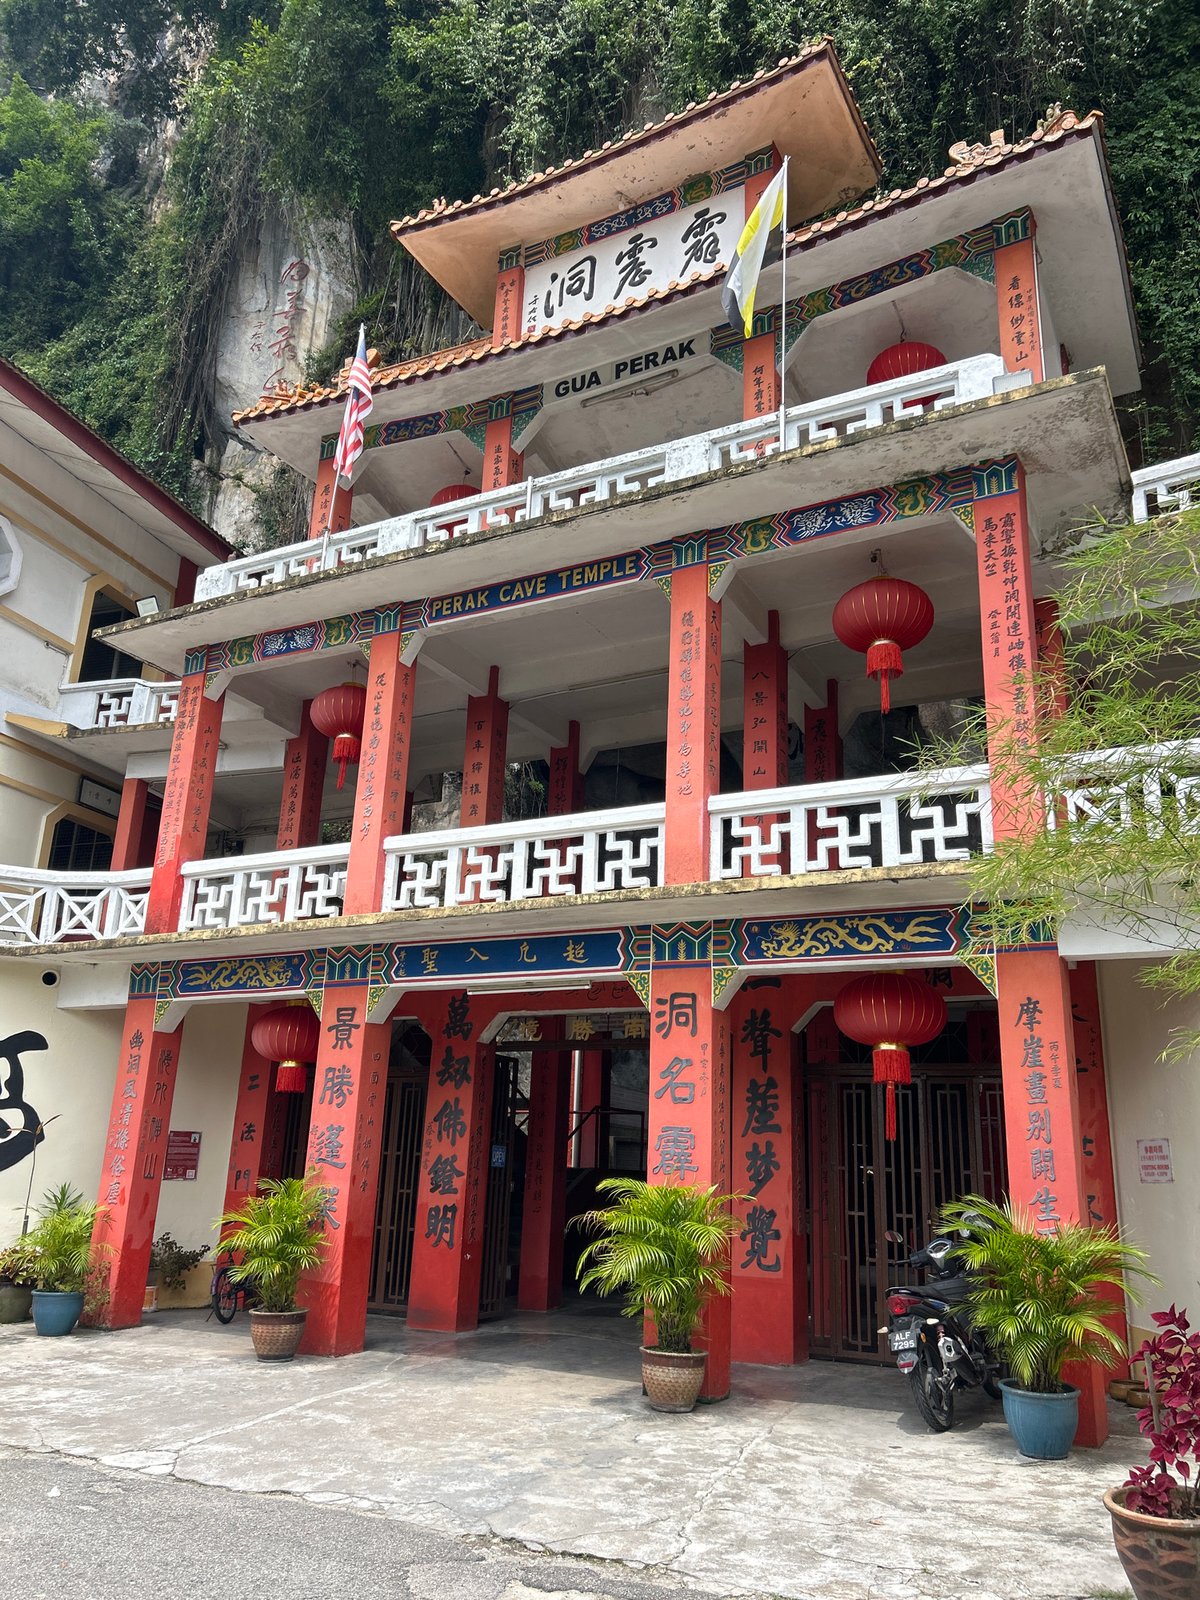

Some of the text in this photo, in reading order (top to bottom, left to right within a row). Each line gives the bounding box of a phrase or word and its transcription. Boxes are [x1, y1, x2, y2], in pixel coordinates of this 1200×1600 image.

[555, 338, 696, 398] GUA PERAK
[432, 555, 637, 618] PERAK CAVE TEMPLE
[492, 1152, 505, 1164] OPEN
[895, 1332, 911, 1341] ALF
[893, 1340, 915, 1350] 7295
